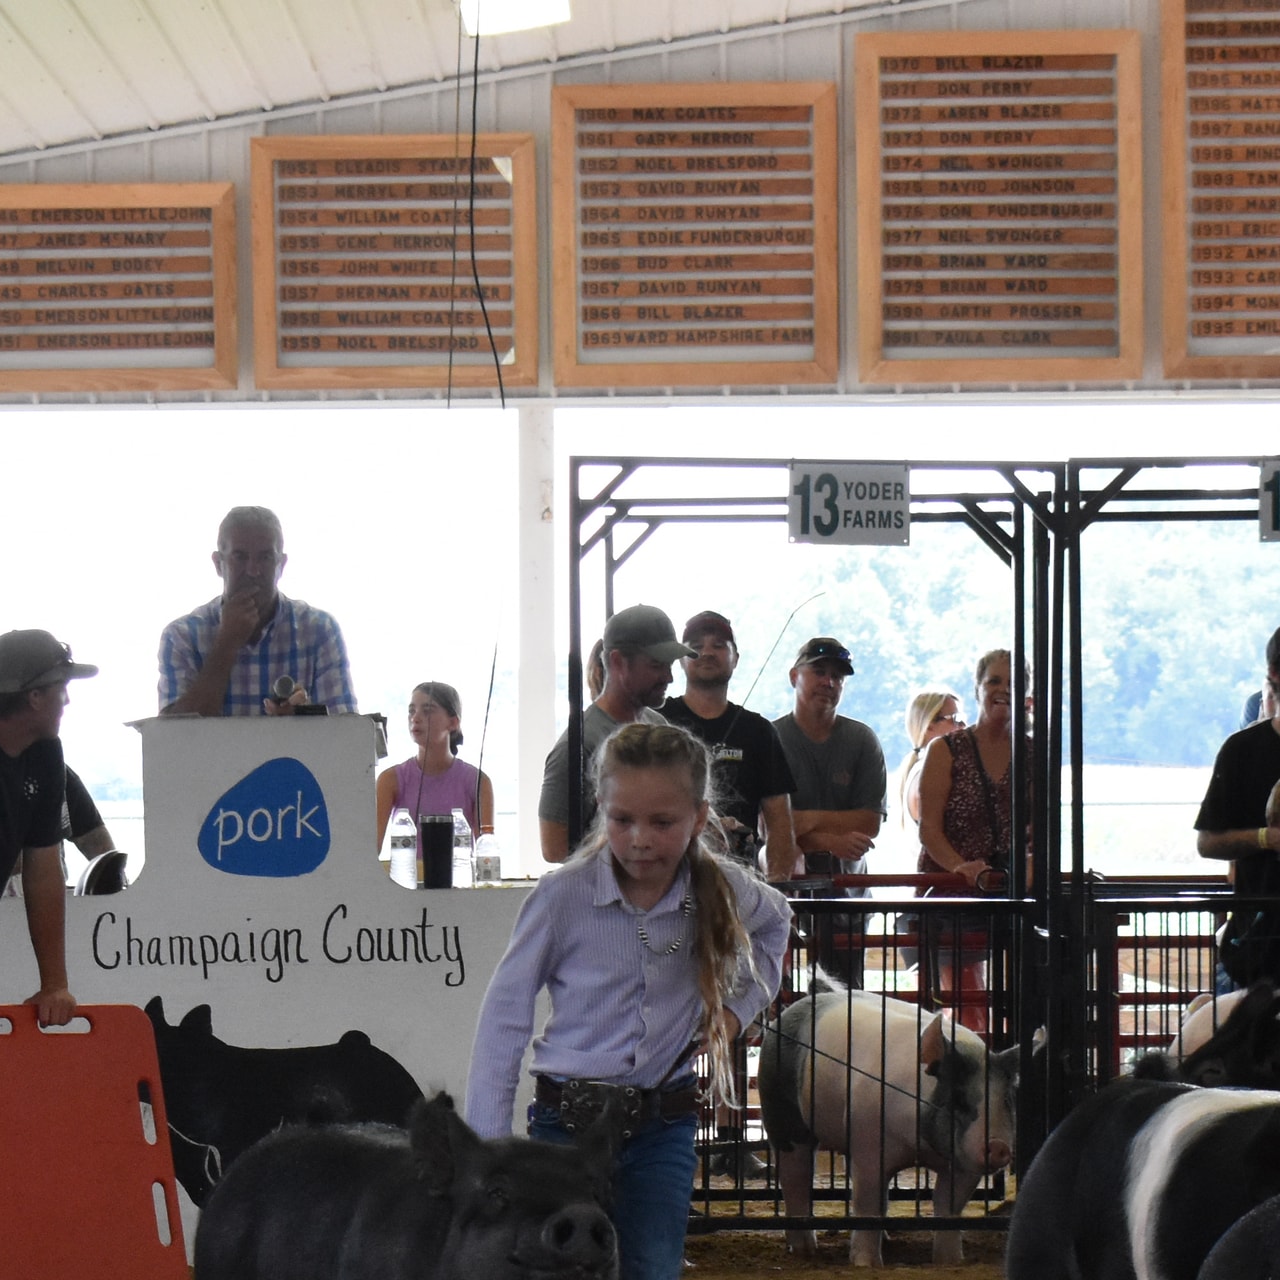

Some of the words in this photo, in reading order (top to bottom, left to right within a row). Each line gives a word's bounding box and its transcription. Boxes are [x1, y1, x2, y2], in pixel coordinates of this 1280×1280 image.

[937, 83, 970, 95] DON
[982, 82, 1032, 94] PERRY
[635, 159, 676, 170] NOEL
[336, 211, 400, 223] WILLIAM
[411, 211, 473, 223] COATES
[638, 207, 685, 219] DAVID
[695, 207, 760, 218] RUNYAN
[1242, 223, 1280, 235] ERIC
[36, 234, 87, 247] JAMES
[336, 236, 378, 249] GENE
[393, 236, 455, 248] HERRON
[638, 231, 683, 244] EDDIE
[885, 230, 922, 242] 1977
[938, 230, 972, 242] NEIL
[36, 260, 94, 272] MELVIN
[339, 262, 379, 274] JOHN
[390, 261, 437, 273] WHITE
[38, 285, 109, 298] CHARLES
[336, 287, 410, 298] SHERMAN
[422, 286, 500, 298] FAULKNER
[639, 282, 686, 294] DAVID
[697, 280, 761, 293] RUNYAN
[940, 280, 986, 292] BRIAN
[1005, 280, 1047, 292] WARD
[35, 309, 109, 322] EMERSON
[116, 307, 213, 321] LITTLEJOHN
[638, 307, 671, 319] BILL
[683, 306, 744, 318] BLAZER
[37, 334, 111, 348] EMERSON
[118, 332, 215, 347] LITTLEJOHN
[337, 336, 377, 348] NOEL
[843, 482, 904, 500] YODER
[793, 473, 839, 536] 13
[843, 510, 904, 529] FARMS
[213, 790, 322, 861] pork
[92, 911, 309, 983] Champaign
[322, 903, 465, 987] County
